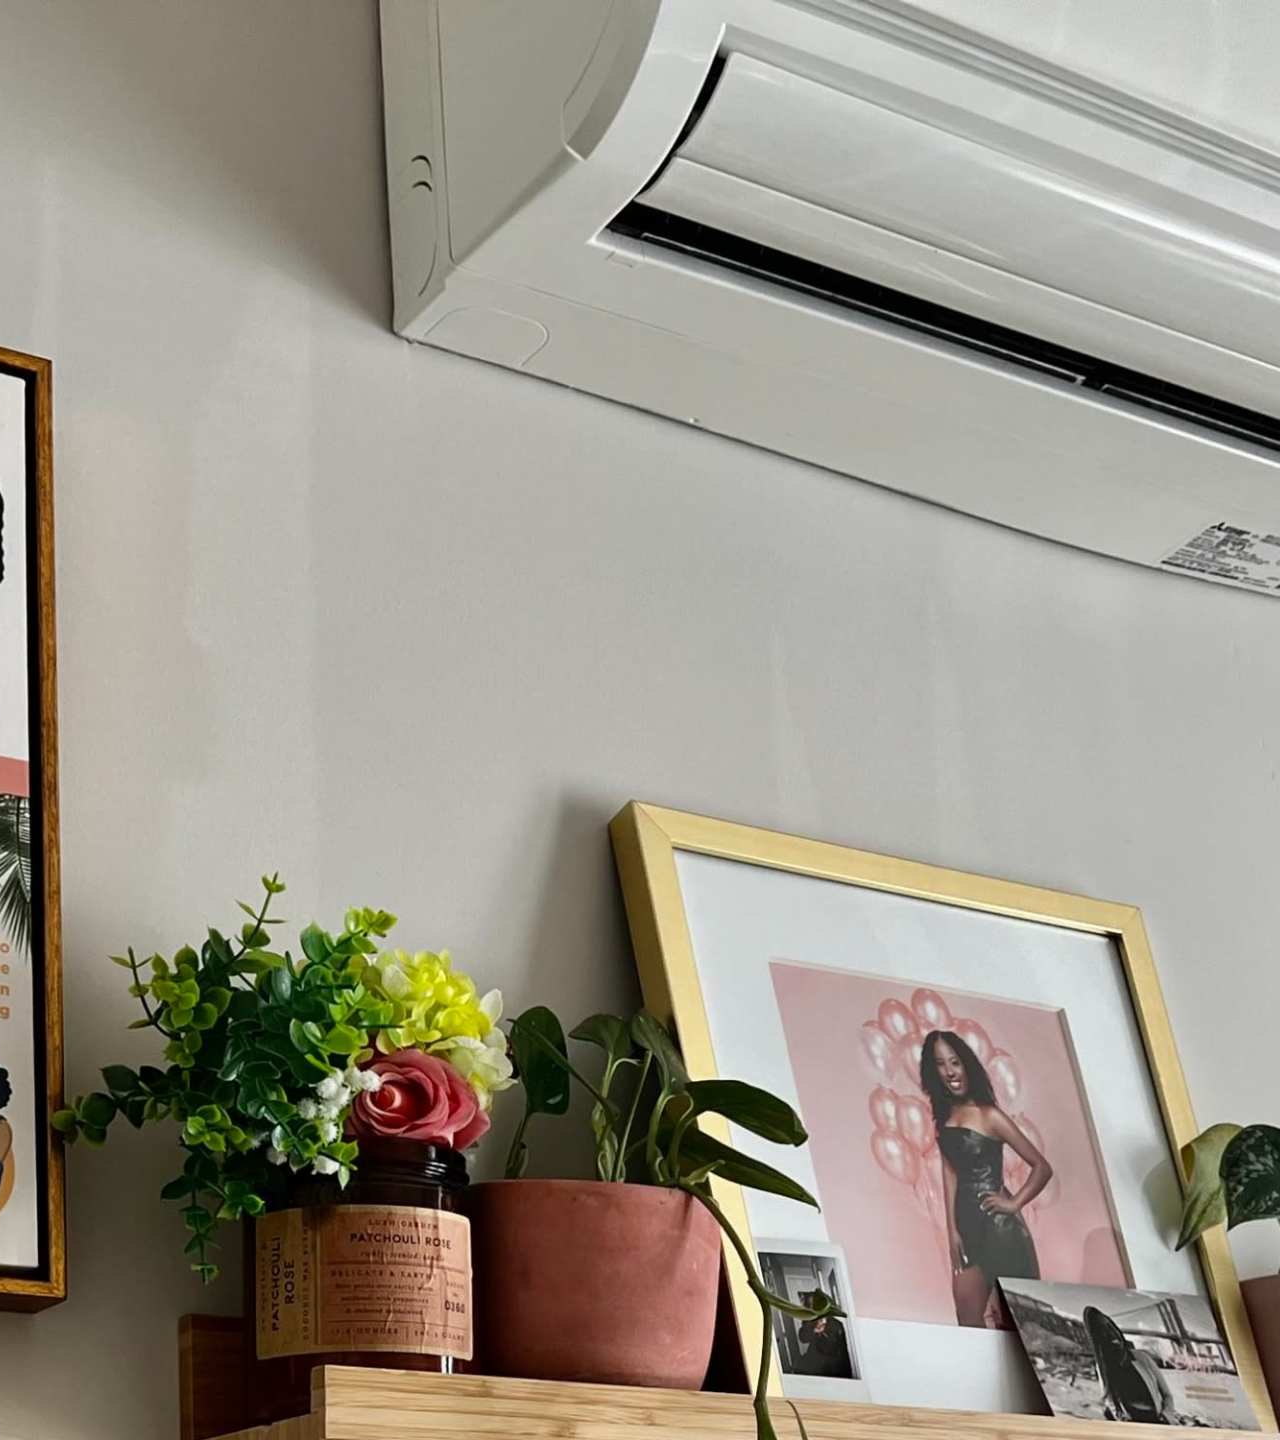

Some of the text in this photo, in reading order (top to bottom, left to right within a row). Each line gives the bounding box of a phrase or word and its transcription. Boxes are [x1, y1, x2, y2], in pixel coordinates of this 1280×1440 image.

[350, 1233, 452, 1250] PATCHOULI ROSE
[271, 1236, 281, 1332] PATCHOULI
[284, 1258, 296, 1305] ROSE
